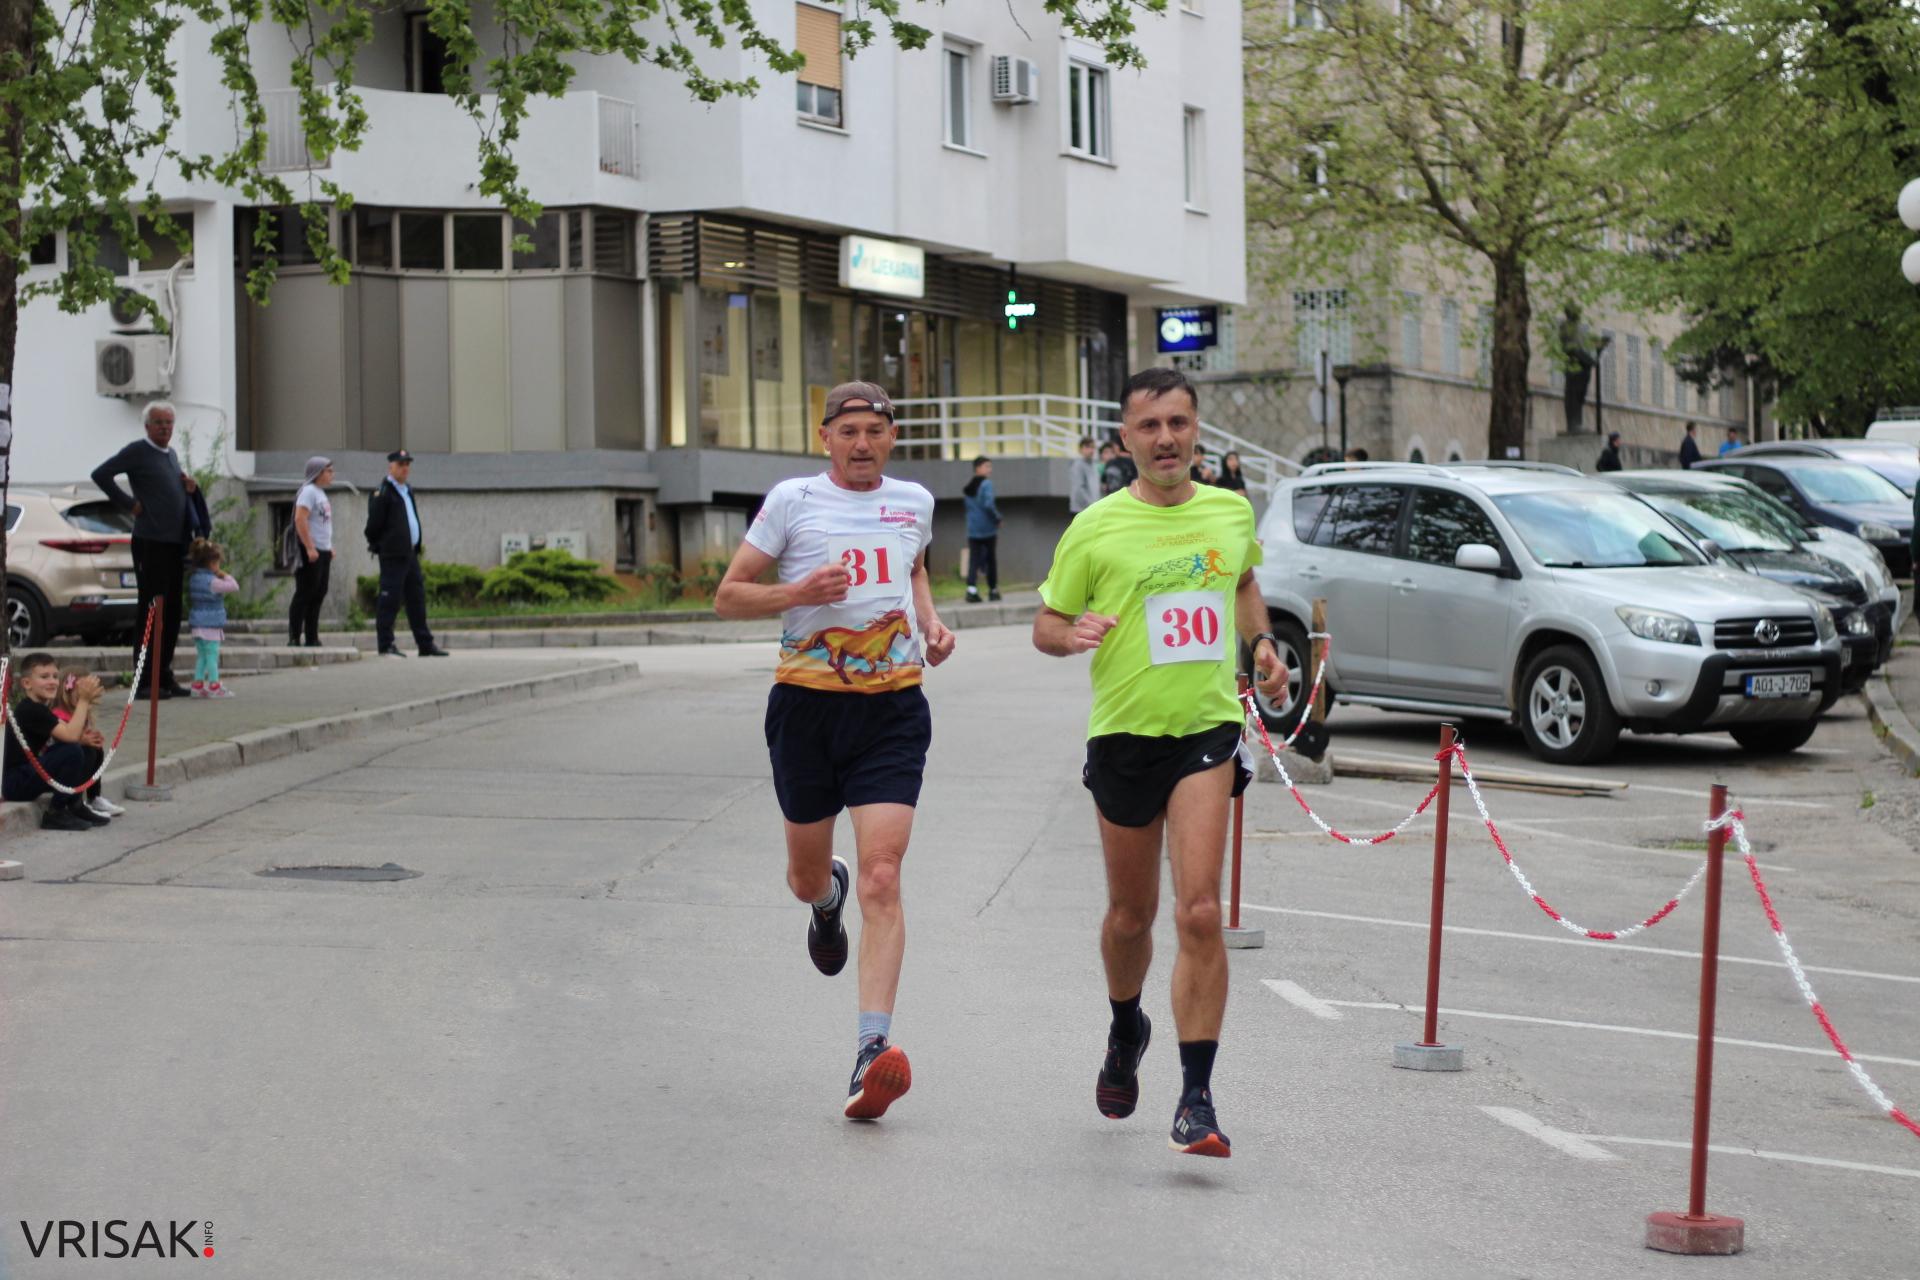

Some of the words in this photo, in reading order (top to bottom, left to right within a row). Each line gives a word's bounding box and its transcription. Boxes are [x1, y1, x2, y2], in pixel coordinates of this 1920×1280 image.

[841, 546, 893, 587] 31
[1162, 606, 1219, 647] 30
[1754, 673, 1809, 693] A01-J-705
